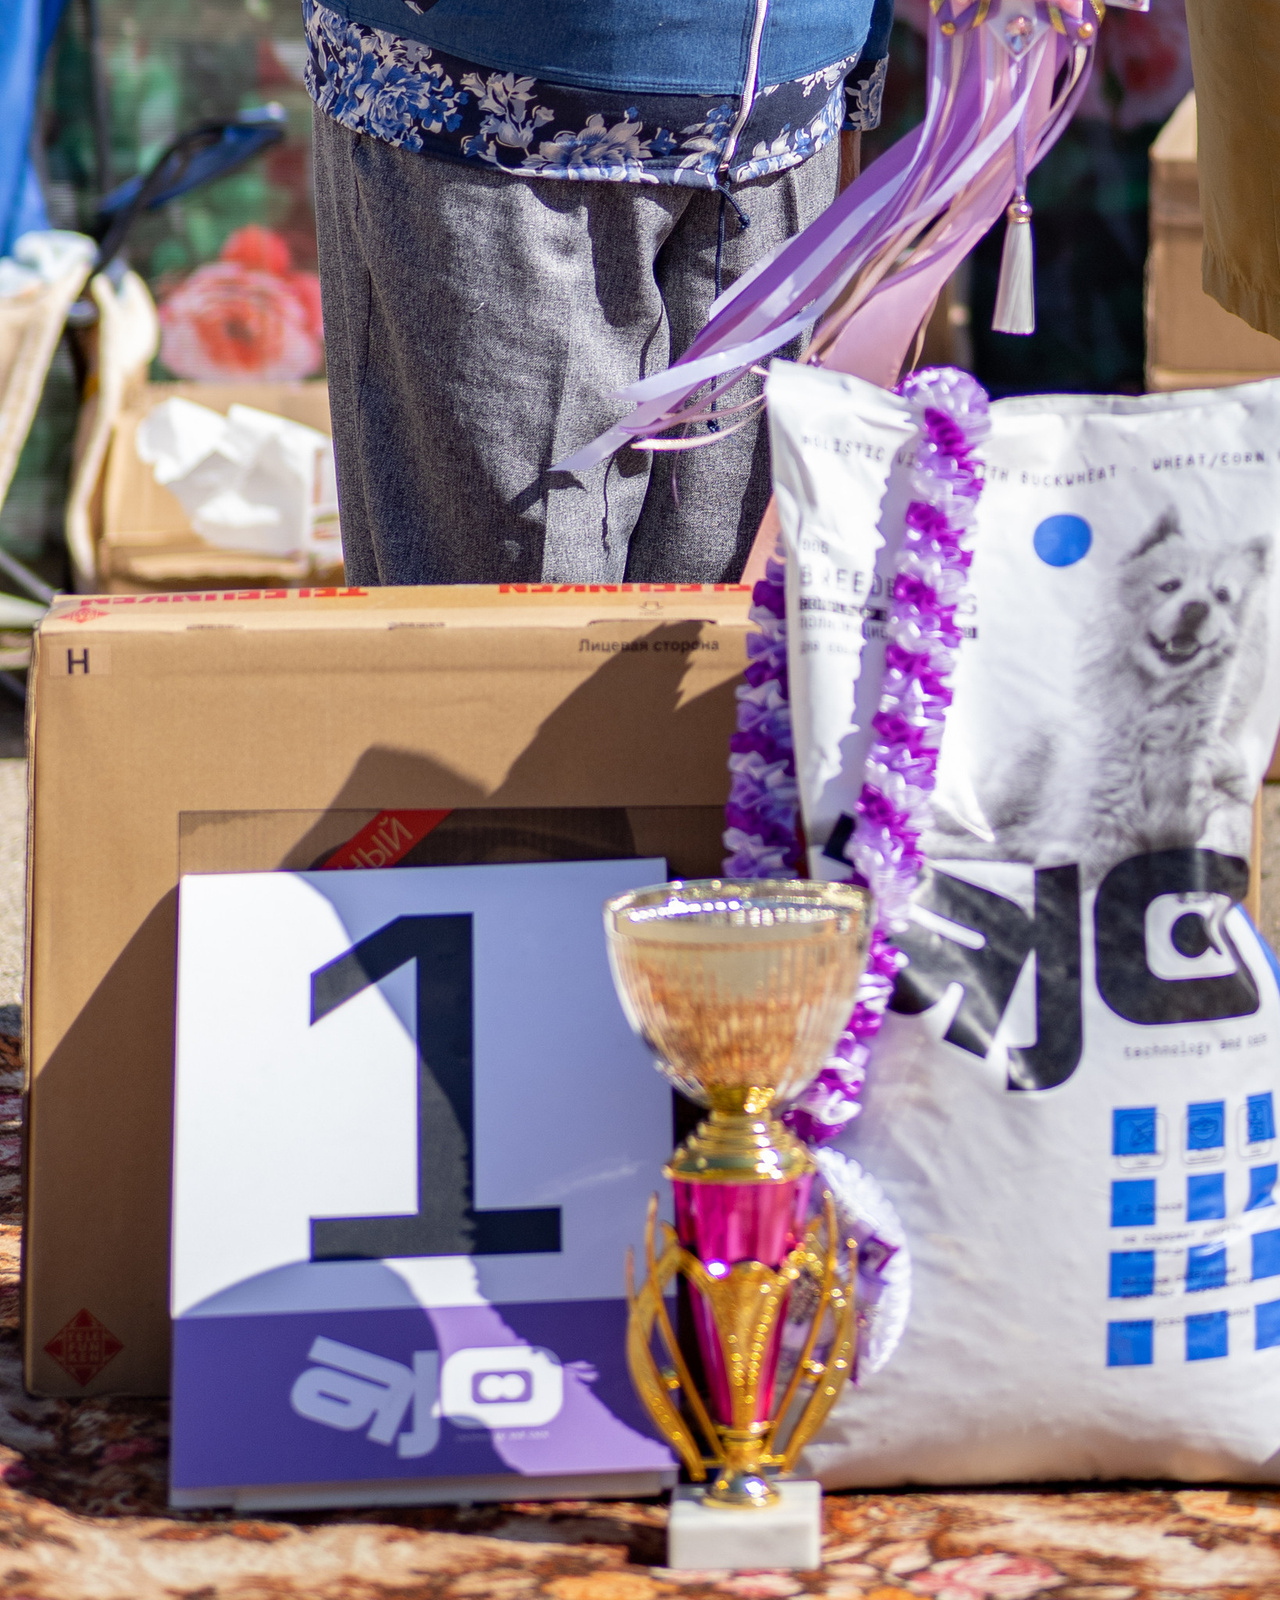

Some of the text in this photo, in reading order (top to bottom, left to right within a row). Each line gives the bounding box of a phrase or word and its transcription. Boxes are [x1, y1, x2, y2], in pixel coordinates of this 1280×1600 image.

[1152, 450, 1265, 472] WHEAT/CORN
[1022, 464, 1118, 487] BUCKWHEAT
[579, 638, 720, 653] Лицевая сторона
[310, 912, 562, 1262] 1
